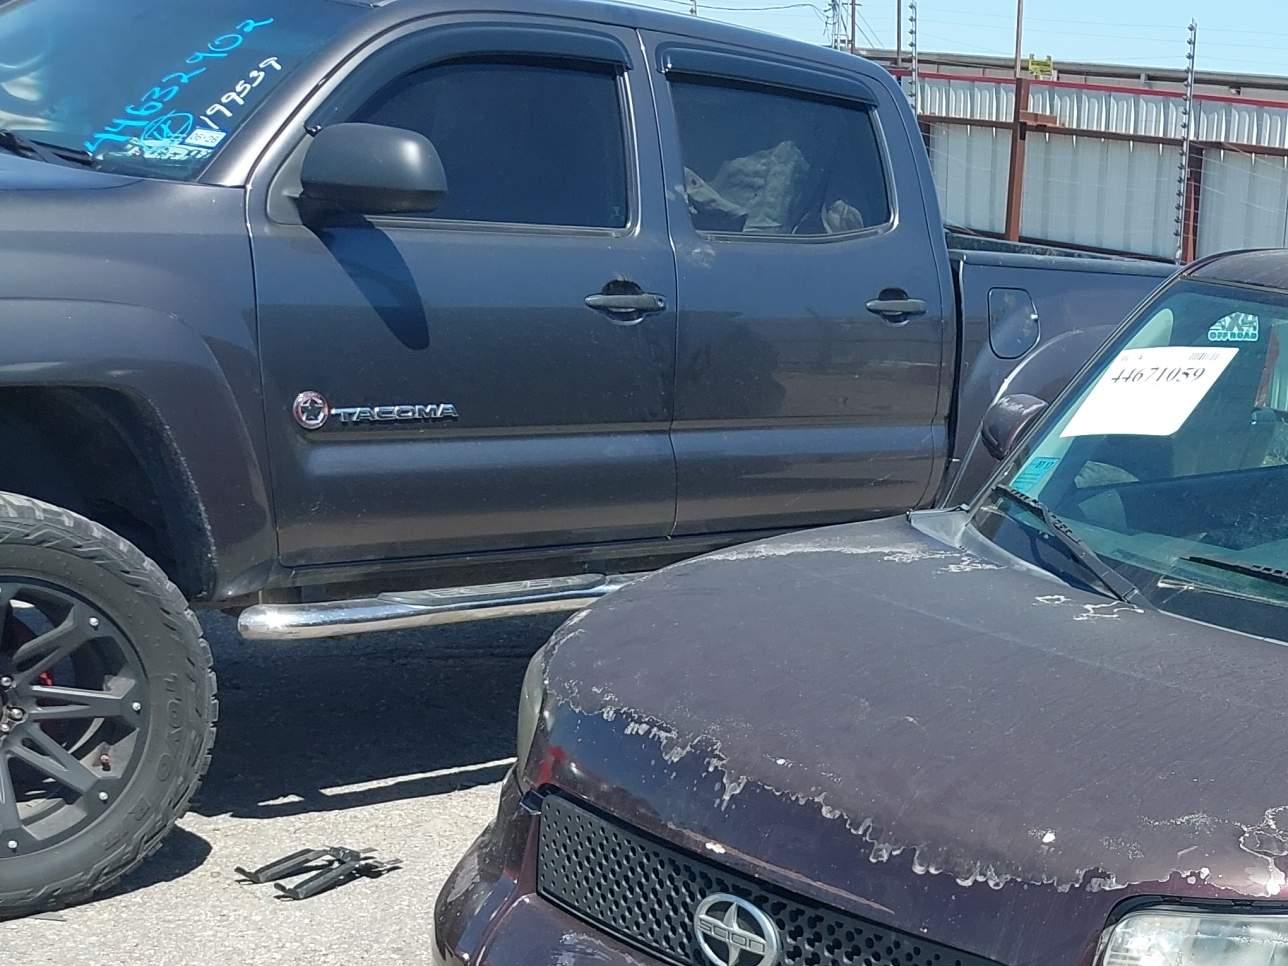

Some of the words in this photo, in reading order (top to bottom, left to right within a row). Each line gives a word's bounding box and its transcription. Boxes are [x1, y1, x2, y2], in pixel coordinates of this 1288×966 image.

[83, 18, 274, 151] 44632902
[1209, 331, 1229, 340] OFF
[1230, 331, 1258, 341] ROAD
[1111, 367, 1207, 383] 44671059
[331, 403, 459, 422] TACOMA
